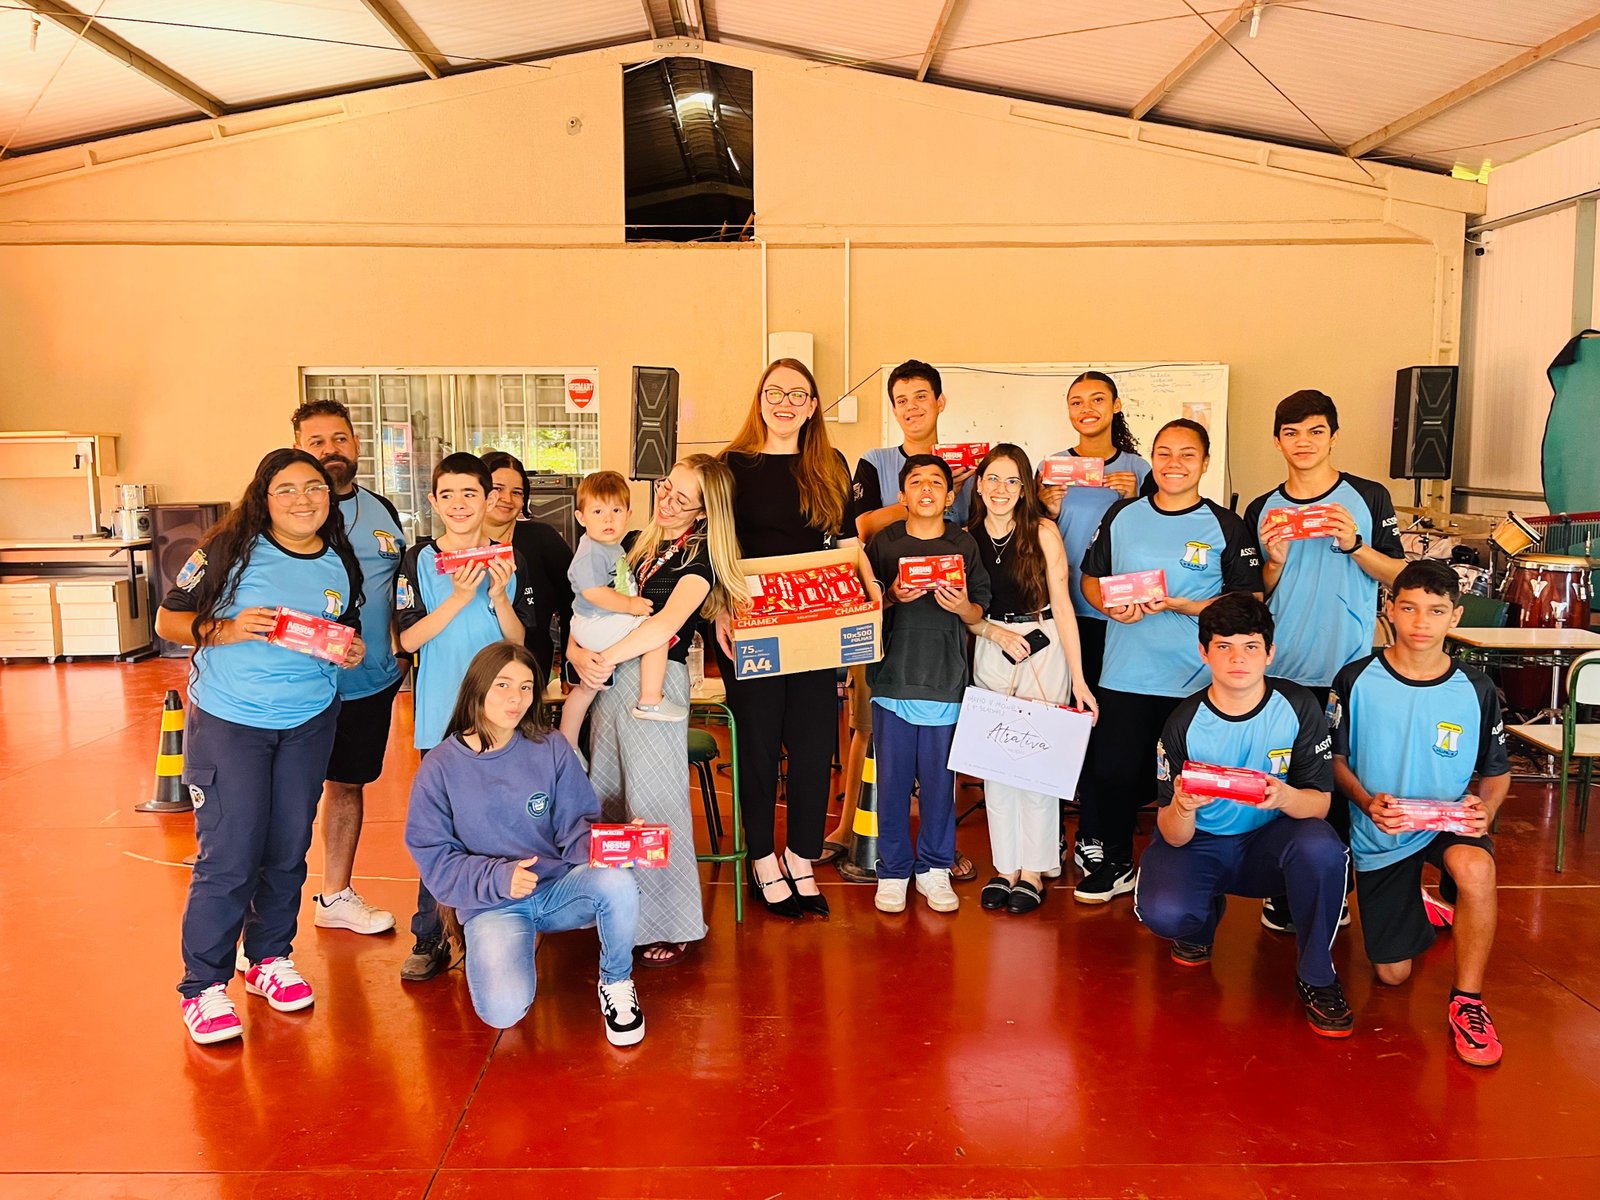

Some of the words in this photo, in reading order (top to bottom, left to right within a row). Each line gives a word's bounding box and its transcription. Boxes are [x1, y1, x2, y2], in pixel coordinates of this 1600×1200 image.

[835, 603, 875, 616] CHAMEX
[737, 617, 779, 628] CHAMEX
[842, 629, 872, 639] 10x500
[741, 657, 772, 674] A4
